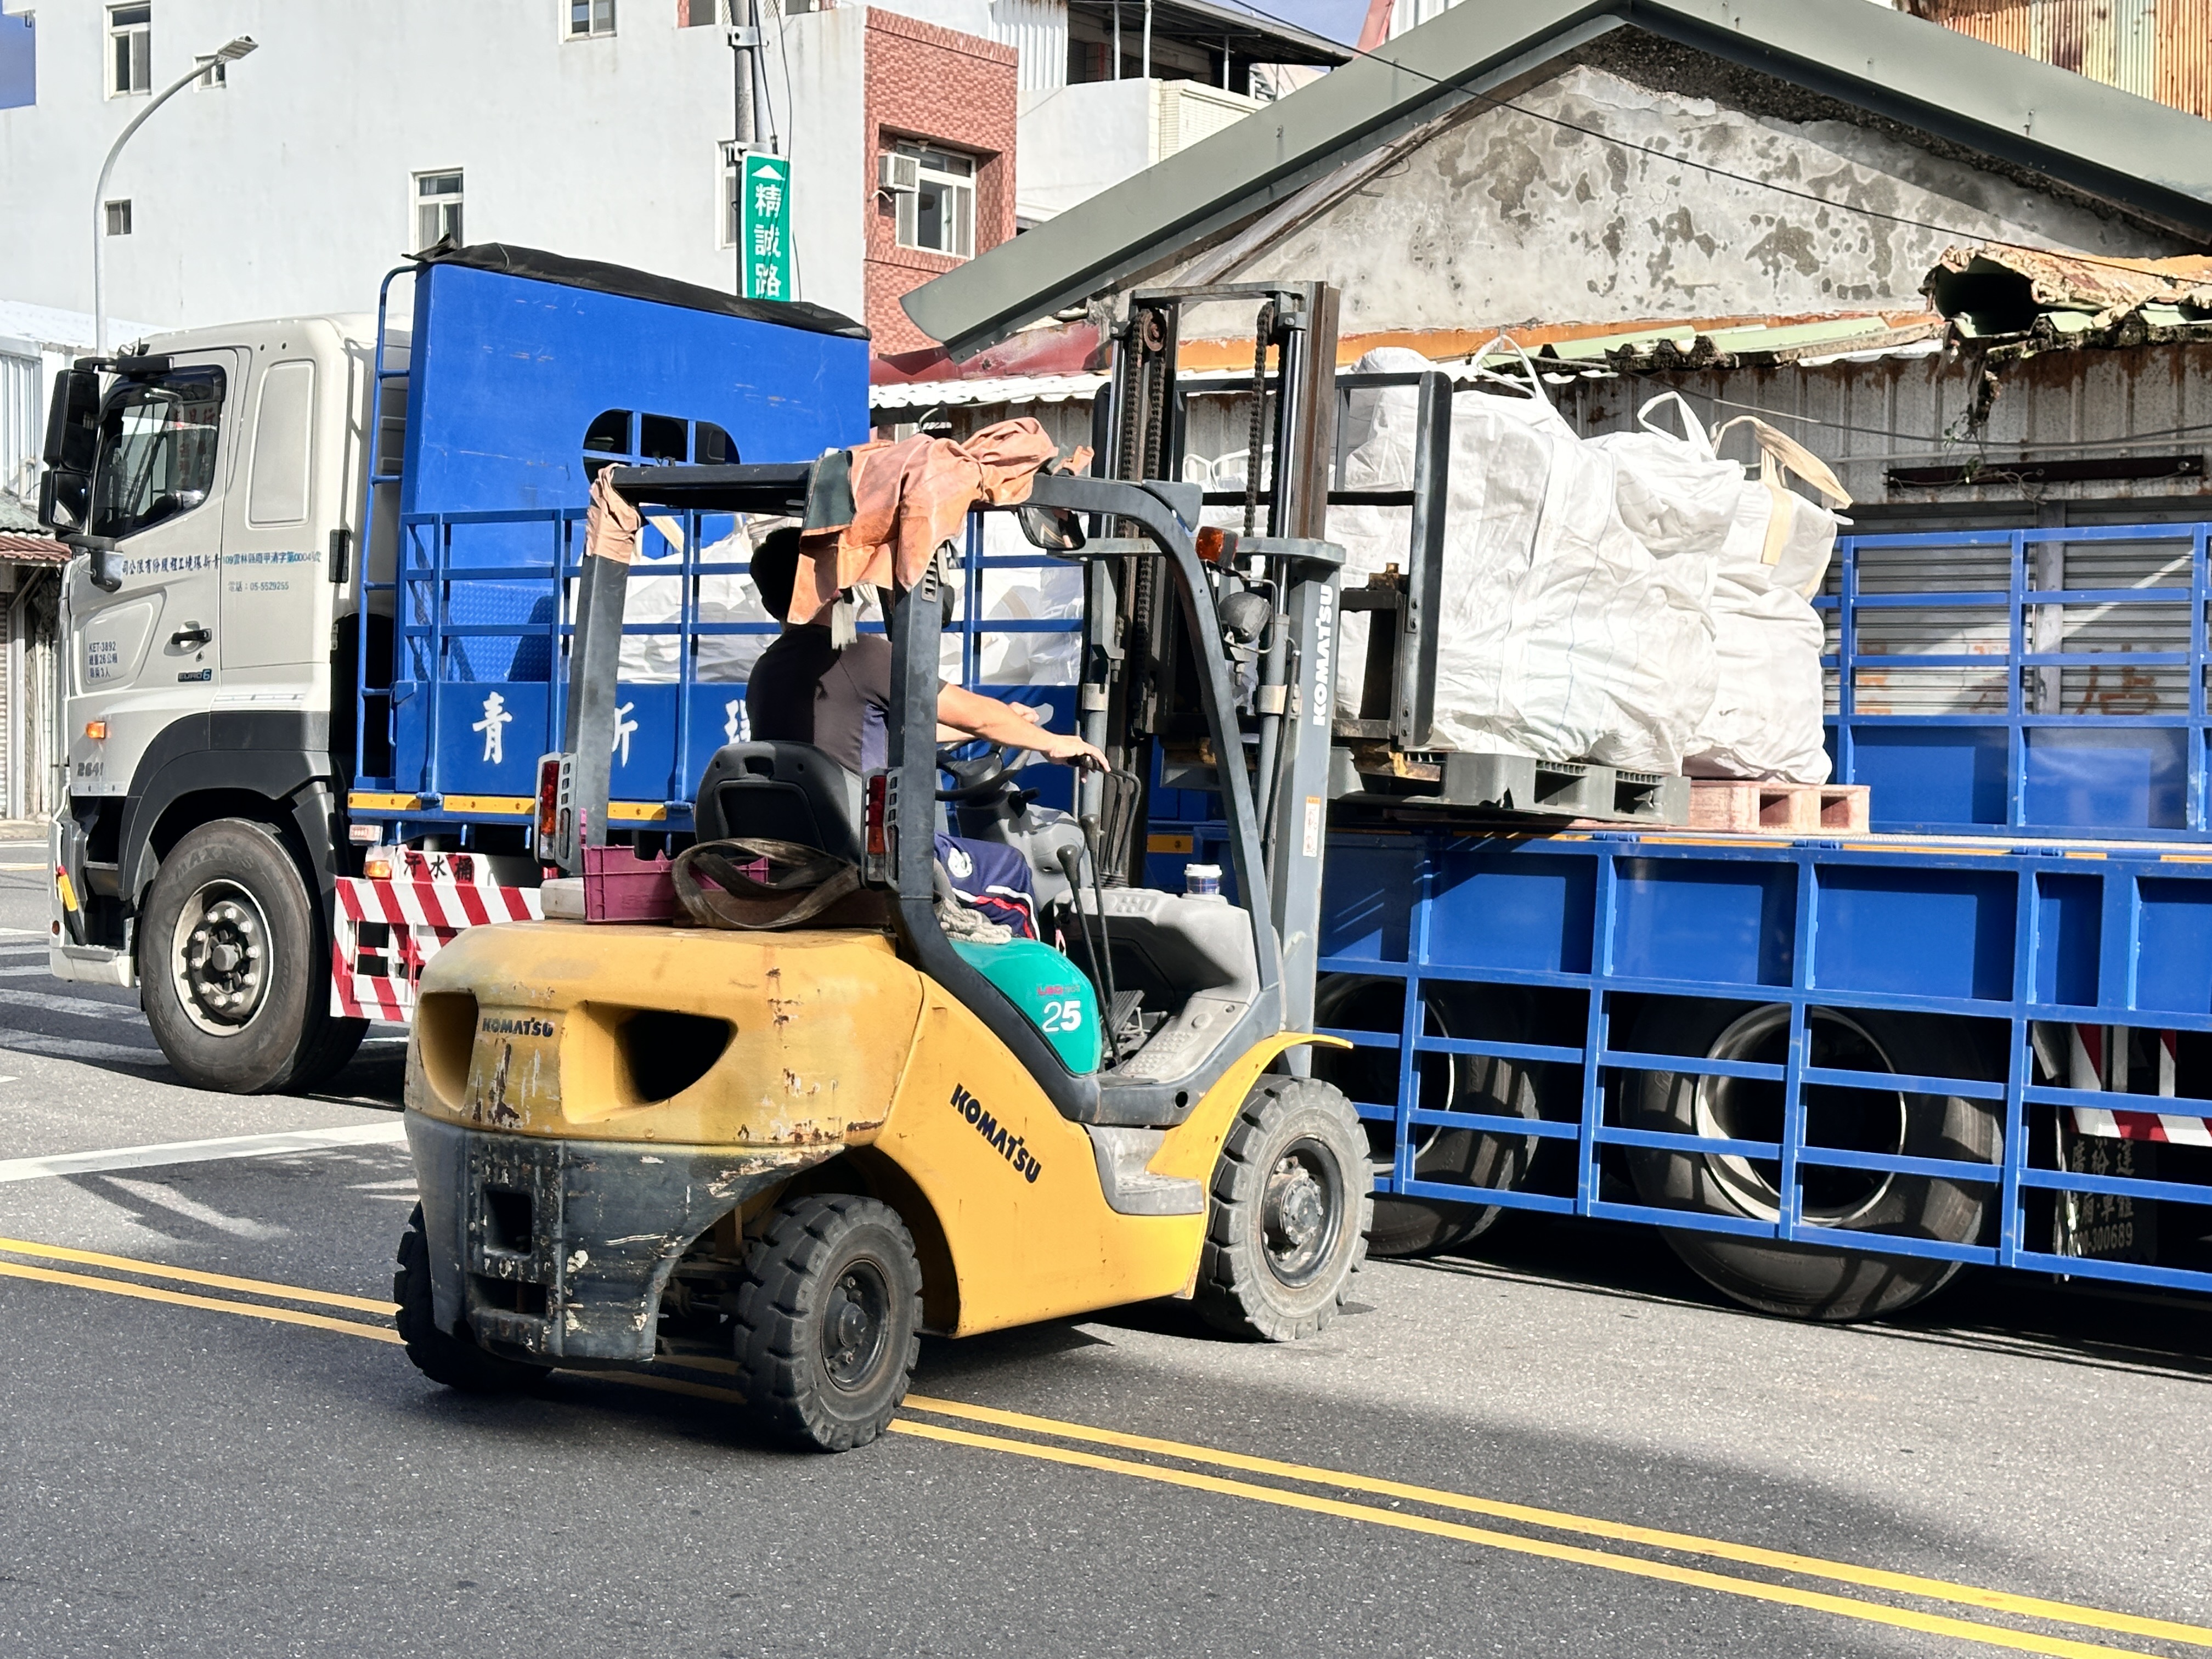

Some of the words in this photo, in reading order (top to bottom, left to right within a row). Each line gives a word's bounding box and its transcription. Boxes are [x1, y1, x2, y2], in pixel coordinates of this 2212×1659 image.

[753, 182, 781, 298] 精誠路
[88, 641, 116, 653] KET-3892
[1313, 584, 1333, 726] KOMATSU
[482, 1017, 554, 1037] KOMATSU
[1042, 1000, 1081, 1032] 25
[950, 1082, 1042, 1184] KOMATSU
